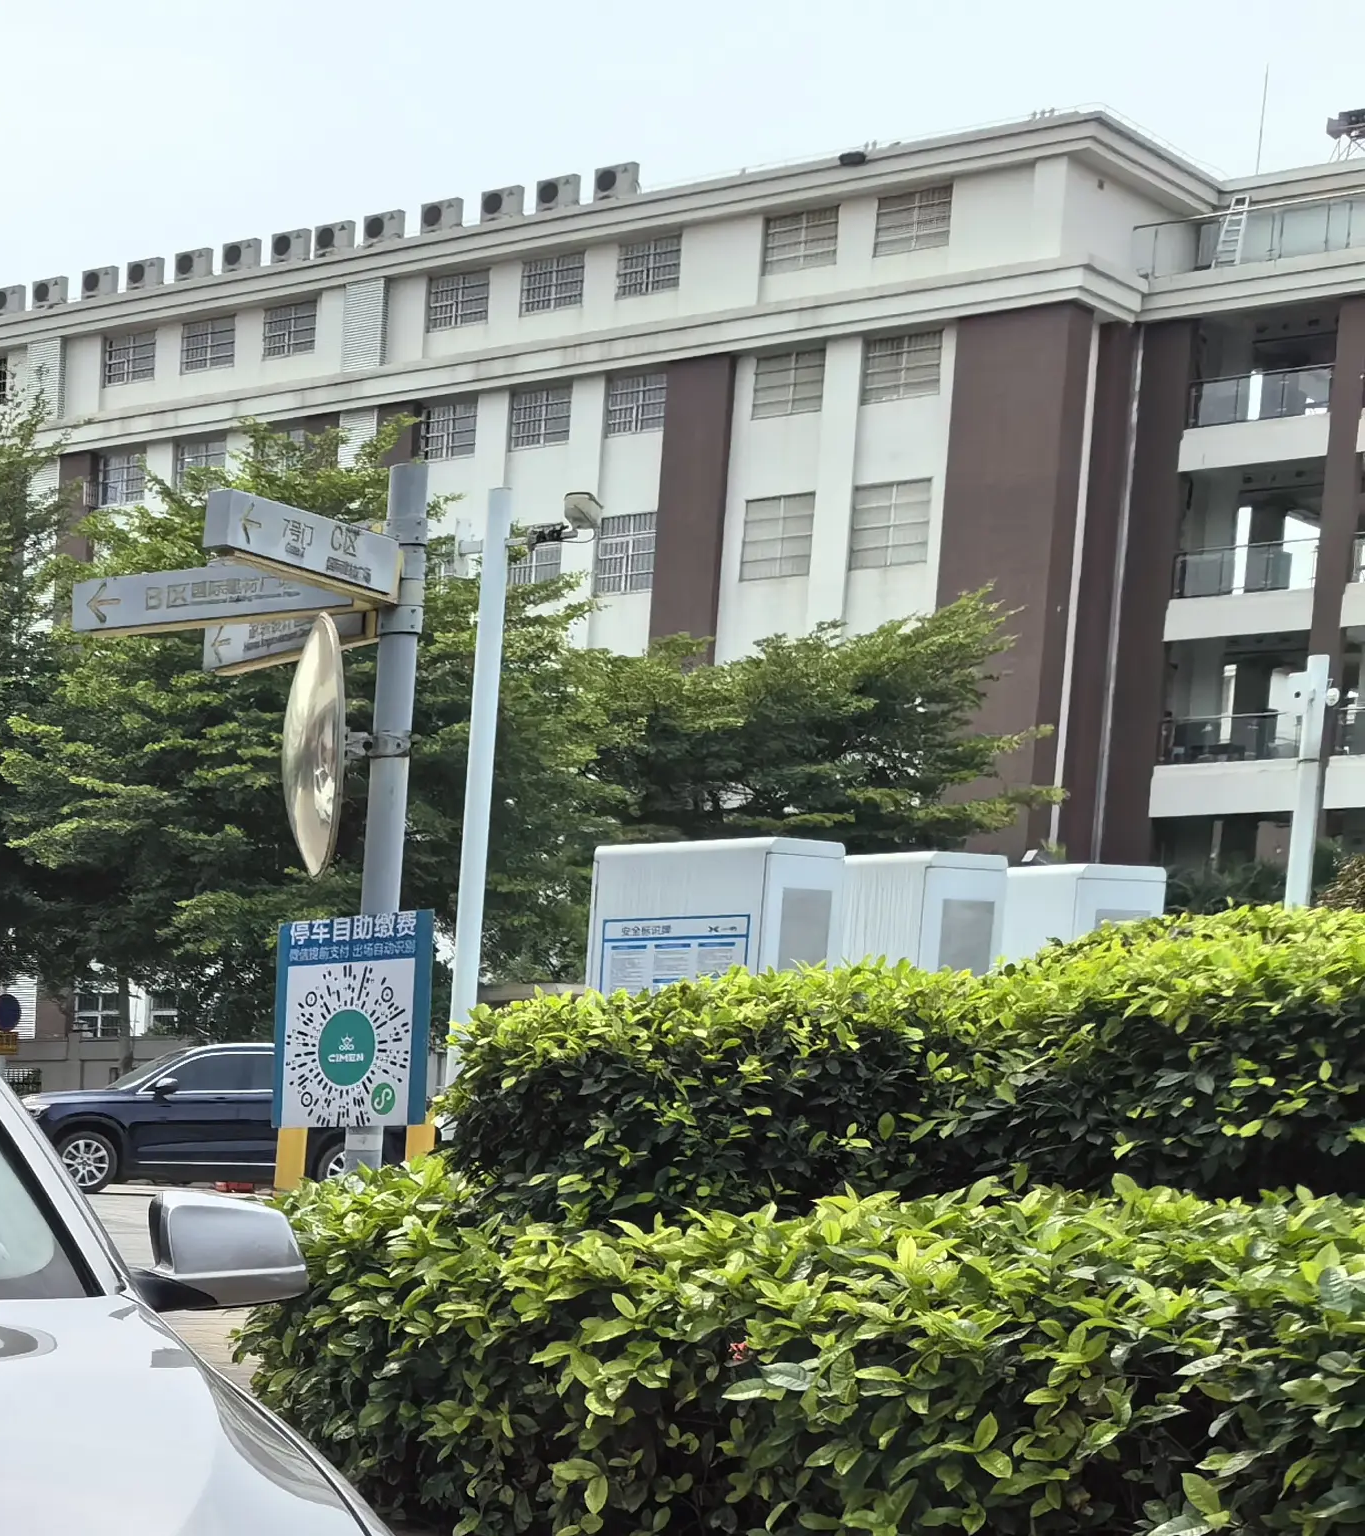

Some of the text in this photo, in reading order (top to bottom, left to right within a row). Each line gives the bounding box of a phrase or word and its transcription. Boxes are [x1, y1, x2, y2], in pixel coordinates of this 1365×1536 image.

[330, 522, 361, 558] C区
[289, 909, 417, 946] 停车自助缴费
